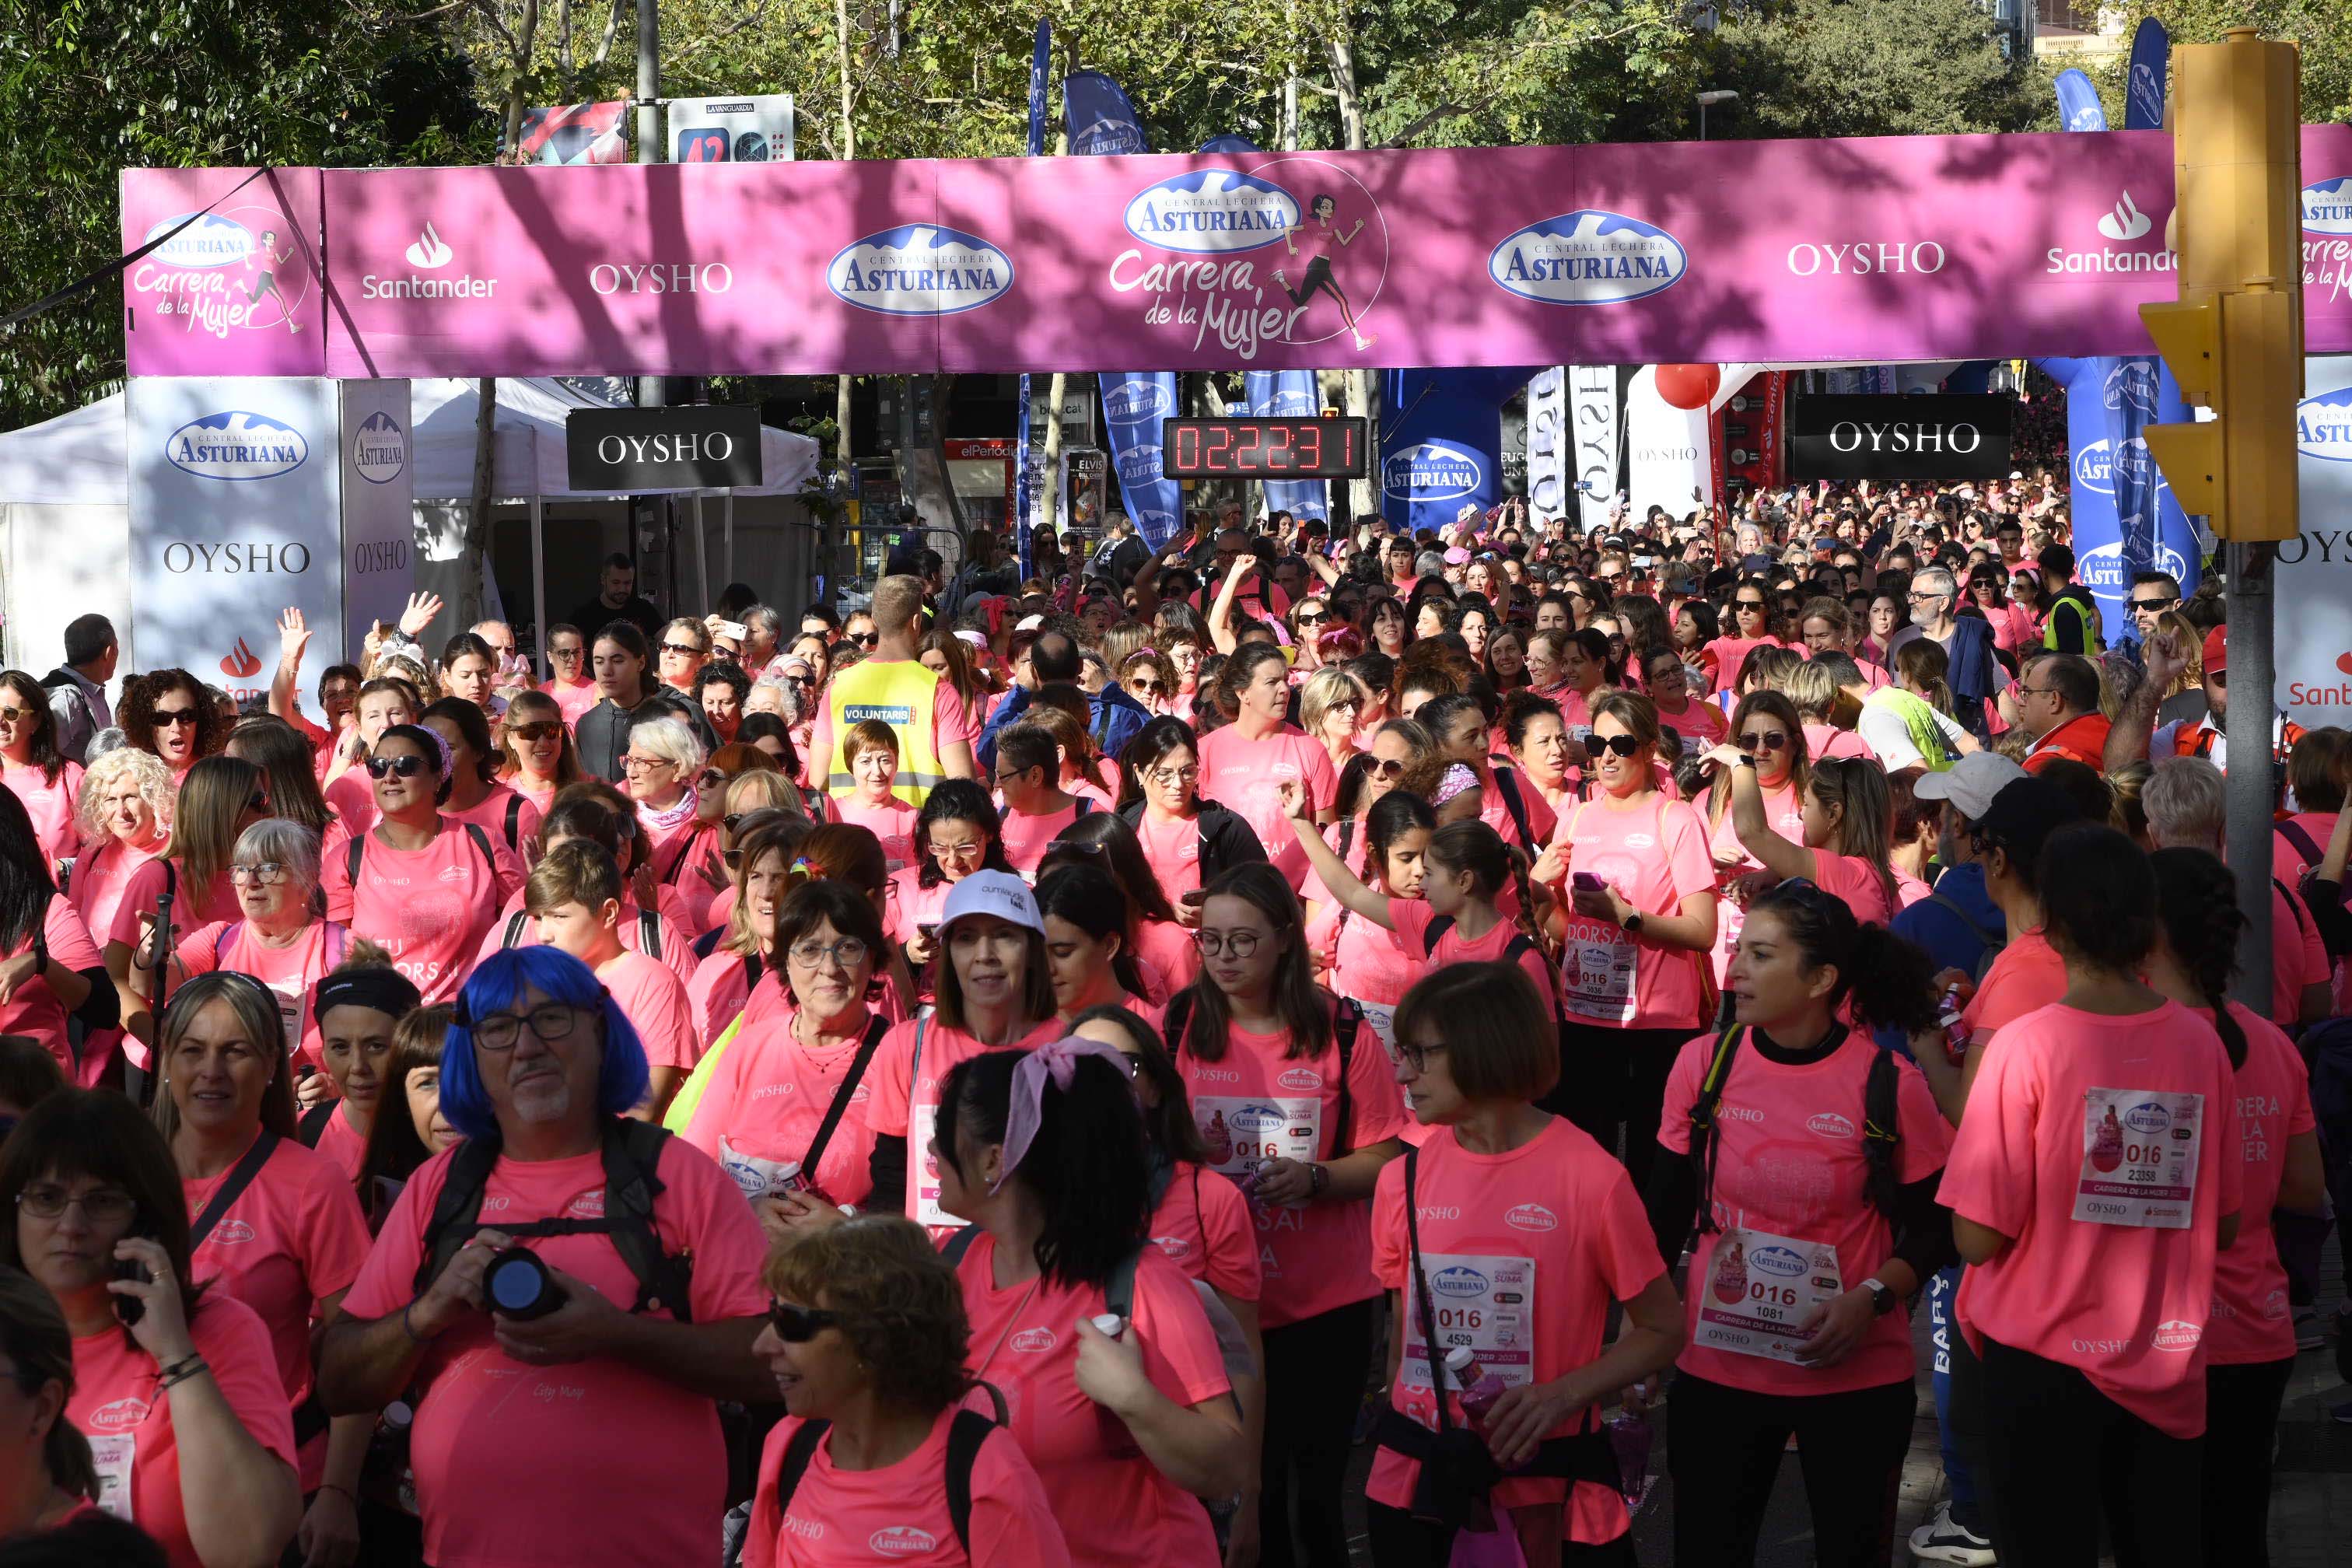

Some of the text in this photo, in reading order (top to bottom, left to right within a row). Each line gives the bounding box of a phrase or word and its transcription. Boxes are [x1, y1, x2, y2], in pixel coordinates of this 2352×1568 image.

[1165, 196, 1283, 208] CENTRAL LECHERA
[1138, 201, 1287, 233] ASTURIANA
[1535, 243, 1665, 254] CENTRAL LECHERA
[1788, 241, 1946, 276] OYSHO
[870, 254, 993, 265] CENTRAL LECHERA
[1504, 246, 1671, 282] ASTURIANA
[134, 264, 226, 293] Carrera
[590, 262, 733, 295] OYSHO
[841, 257, 999, 292] ASTURIANA
[1109, 248, 1255, 292] Carrera
[2317, 262, 2329, 285] la
[362, 274, 498, 299] Santander
[156, 290, 261, 339] de la Mujer
[1145, 287, 1309, 360] de la Mujer
[1176, 425, 1350, 470] 02:22:31
[1830, 421, 1981, 454] OYSHO
[177, 436, 299, 464] ASTURIANA
[357, 437, 403, 467] ASTURIANA
[597, 431, 733, 465] OYSHO
[1636, 446, 1698, 461] OYSHO
[1079, 460, 1103, 470] ELVIS
[1385, 467, 1474, 488] ASTURIANA
[163, 542, 311, 574] OYSHO
[355, 539, 407, 575] OYSHO
[845, 709, 908, 720] VOLUNTARIS
[1567, 923, 1629, 946] DORSA
[1582, 971, 1607, 985] 016
[1586, 985, 1602, 995] 5036
[752, 1082, 794, 1101] OYSHO
[1281, 1076, 1320, 1087] ASTURIANA
[2236, 1095, 2280, 1118] RERA
[1234, 1115, 1280, 1128] ASTURIANA
[1810, 1119, 1851, 1134] ASTURIANA
[1235, 1141, 1279, 1159] 016
[2126, 1144, 2162, 1164] 016
[2127, 1169, 2157, 1182] 23358
[2093, 1185, 2129, 1195] CARRERA
[2129, 1186, 2140, 1195] DE
[2140, 1187, 2149, 1195] LA
[1507, 1210, 1555, 1227] ASTURIANA
[2087, 1202, 2127, 1215] OYSHO
[1752, 1253, 1804, 1274] ASTURIANA
[1436, 1276, 1485, 1291] ASTURIANA
[1493, 1274, 1523, 1283] SUMA
[1750, 1282, 1797, 1306] 016
[1439, 1308, 1482, 1328] 016
[1714, 1313, 1752, 1328] CARRERA
[1765, 1323, 1776, 1332] LA
[1755, 1305, 1784, 1321] 1081
[1447, 1333, 1473, 1346] 4529
[1708, 1328, 1750, 1346] OYSHO
[874, 1535, 930, 1551] ASTURIANA
